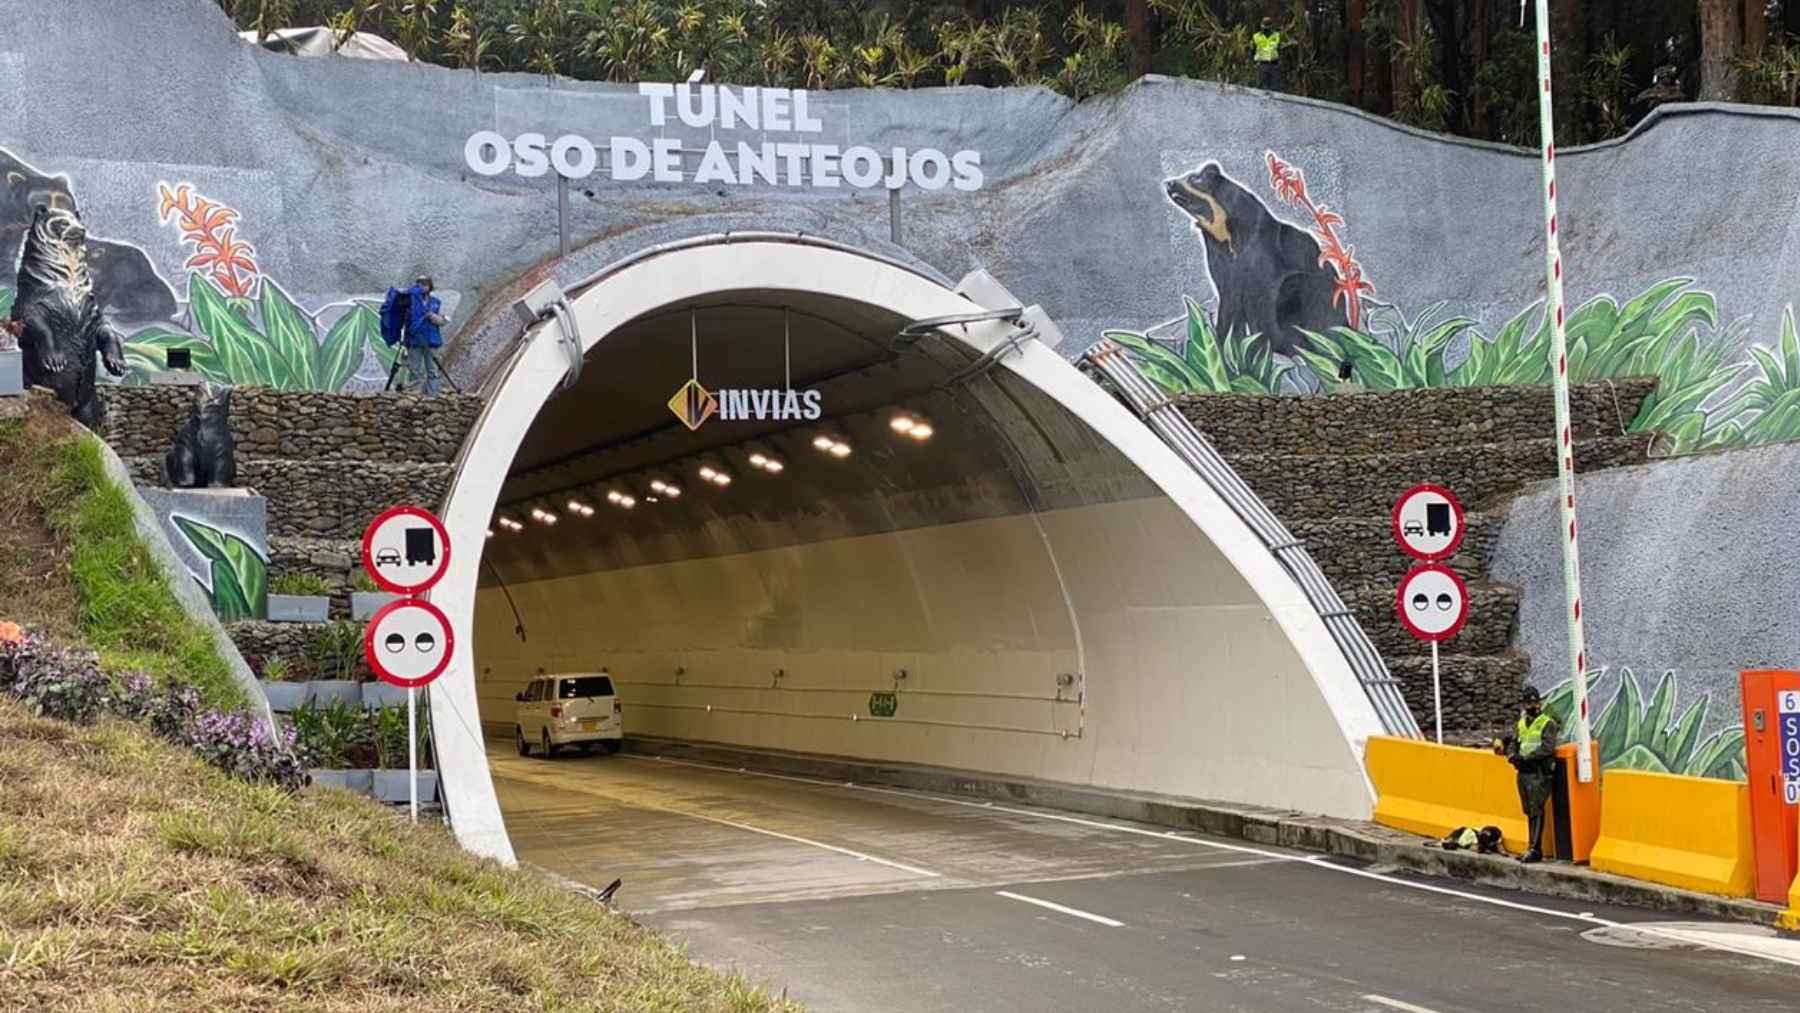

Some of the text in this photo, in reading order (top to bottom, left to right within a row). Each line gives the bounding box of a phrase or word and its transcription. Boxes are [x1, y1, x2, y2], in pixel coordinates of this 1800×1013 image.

[638, 69, 823, 133] TÚNEL
[464, 130, 985, 192] OSO DE ANTEOJOS
[718, 388, 822, 421] INVIAS
[1786, 717, 1800, 777] SOS
